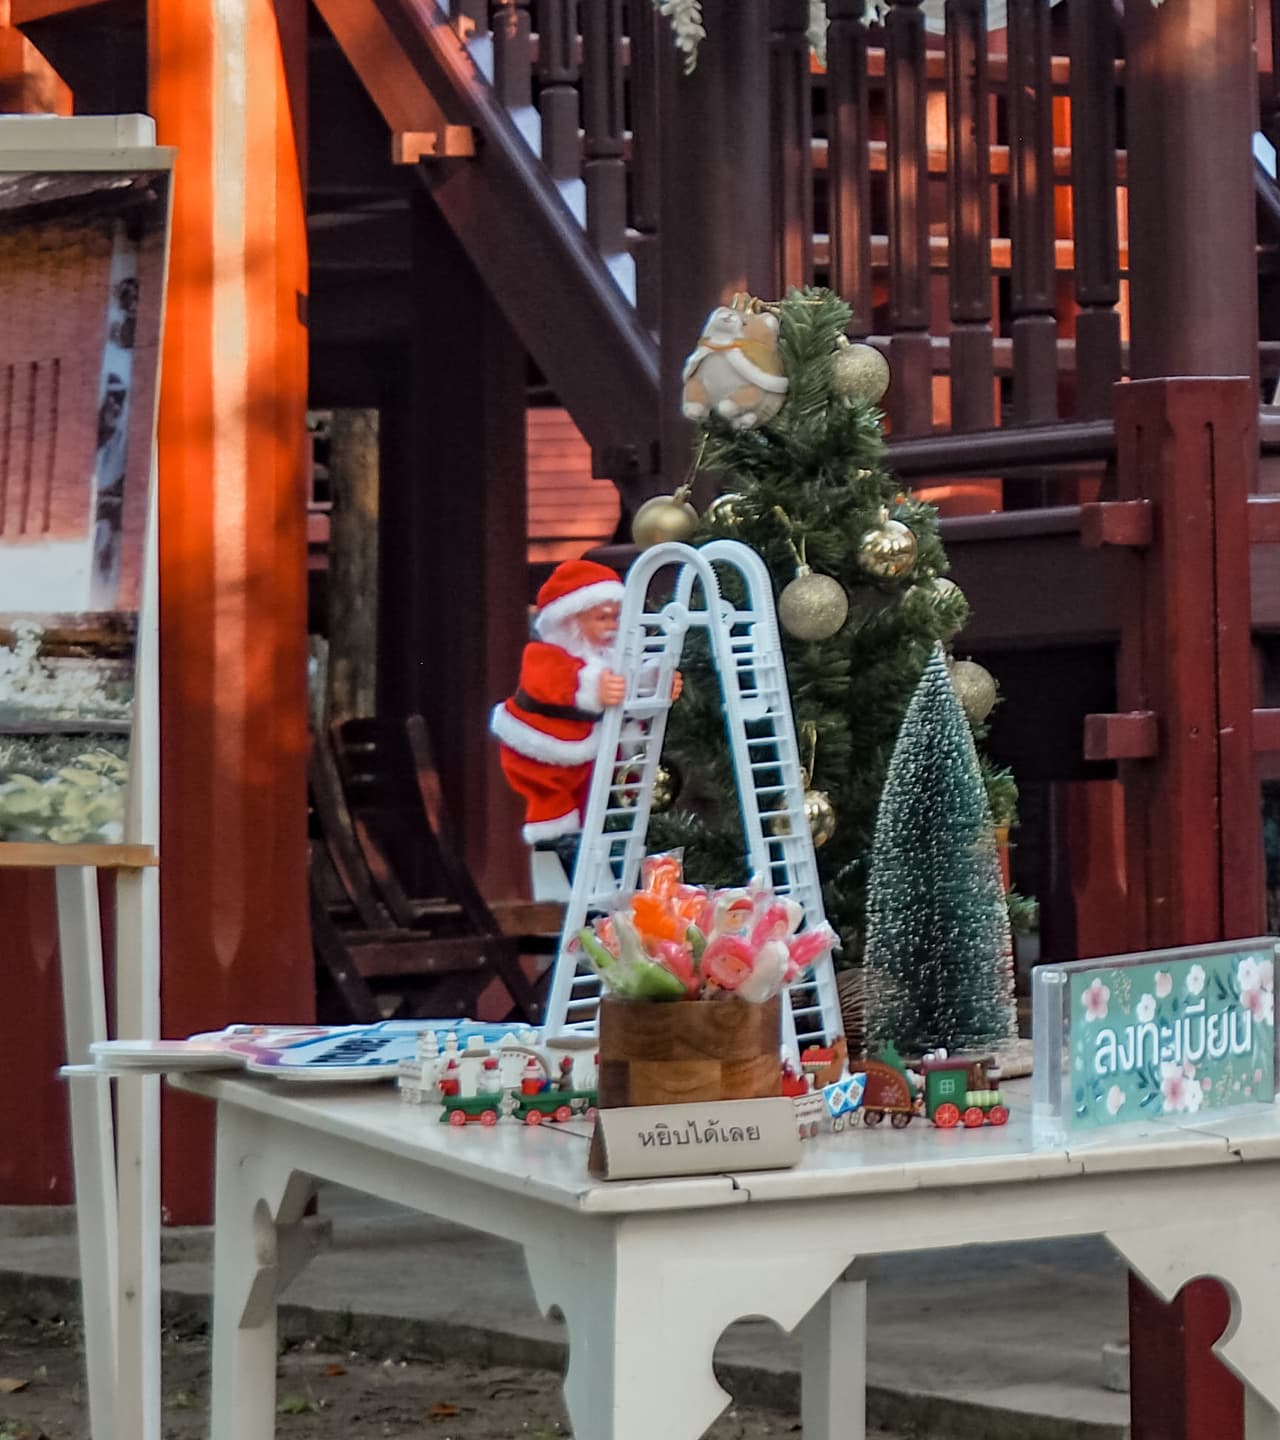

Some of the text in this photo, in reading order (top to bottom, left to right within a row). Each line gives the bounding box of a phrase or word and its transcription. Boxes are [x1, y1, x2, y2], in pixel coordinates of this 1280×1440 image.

[1094, 998, 1252, 1074] ลงทะเบียน
[637, 1119, 761, 1148] หยิบได้เลย
